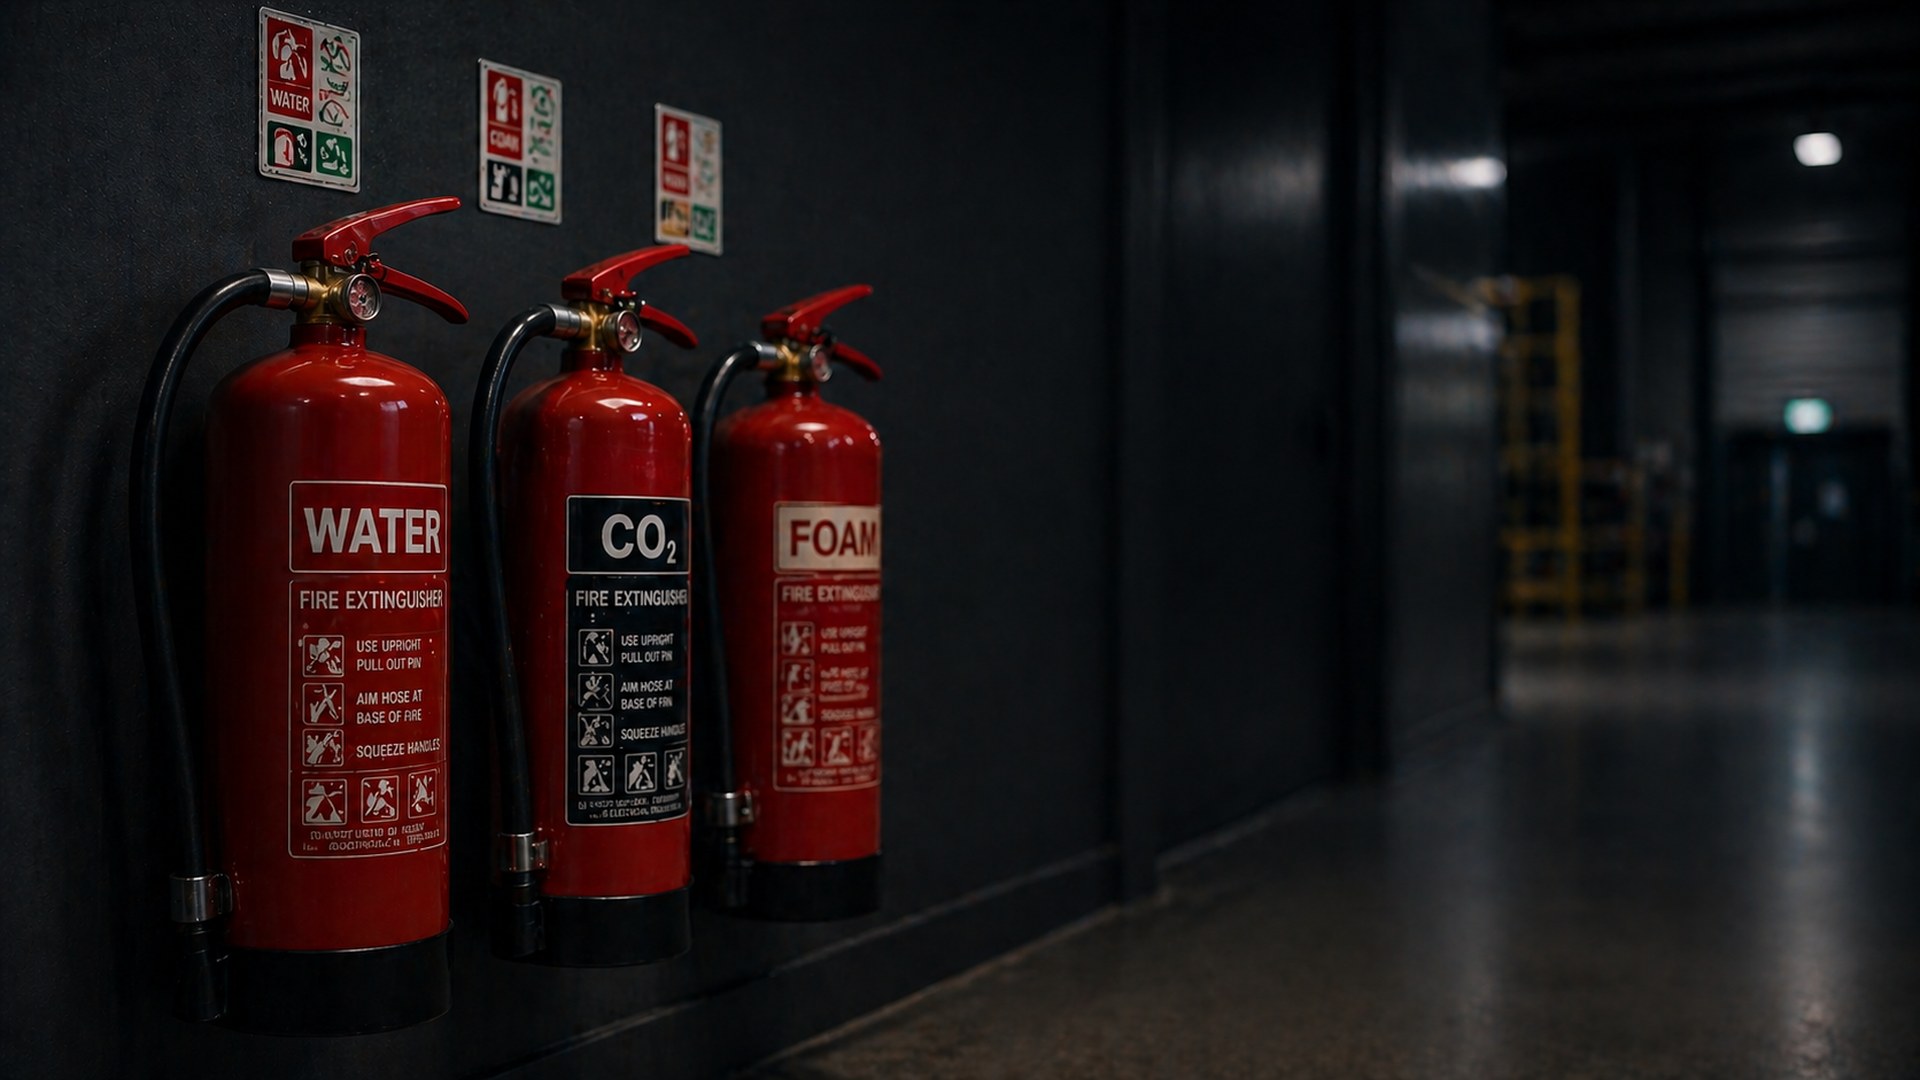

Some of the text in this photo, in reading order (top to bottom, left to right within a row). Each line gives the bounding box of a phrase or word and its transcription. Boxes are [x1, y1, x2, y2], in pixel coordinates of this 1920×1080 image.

[269, 87, 311, 115] WATER
[303, 507, 441, 554] WATER
[790, 520, 878, 556] FOAM
[299, 589, 443, 610] FIRE EXTINGUISHER
[576, 590, 609, 606] FIRE
[781, 585, 814, 602] FIRE
[356, 638, 422, 653] USE UPRIGHT
[621, 634, 639, 646] USE
[356, 657, 422, 671] PULL OUT PIN
[621, 652, 643, 663] PULL
[644, 651, 660, 662] OUT
[620, 682, 639, 693] AIM
[356, 689, 423, 705] AIM HOSE AT
[621, 698, 645, 710] BASE
[646, 697, 657, 709] OF
[356, 711, 385, 725] BASE
[388, 710, 402, 723] OF
[620, 727, 660, 741] SQUEEZE
[356, 743, 405, 759] SQUEEZE
